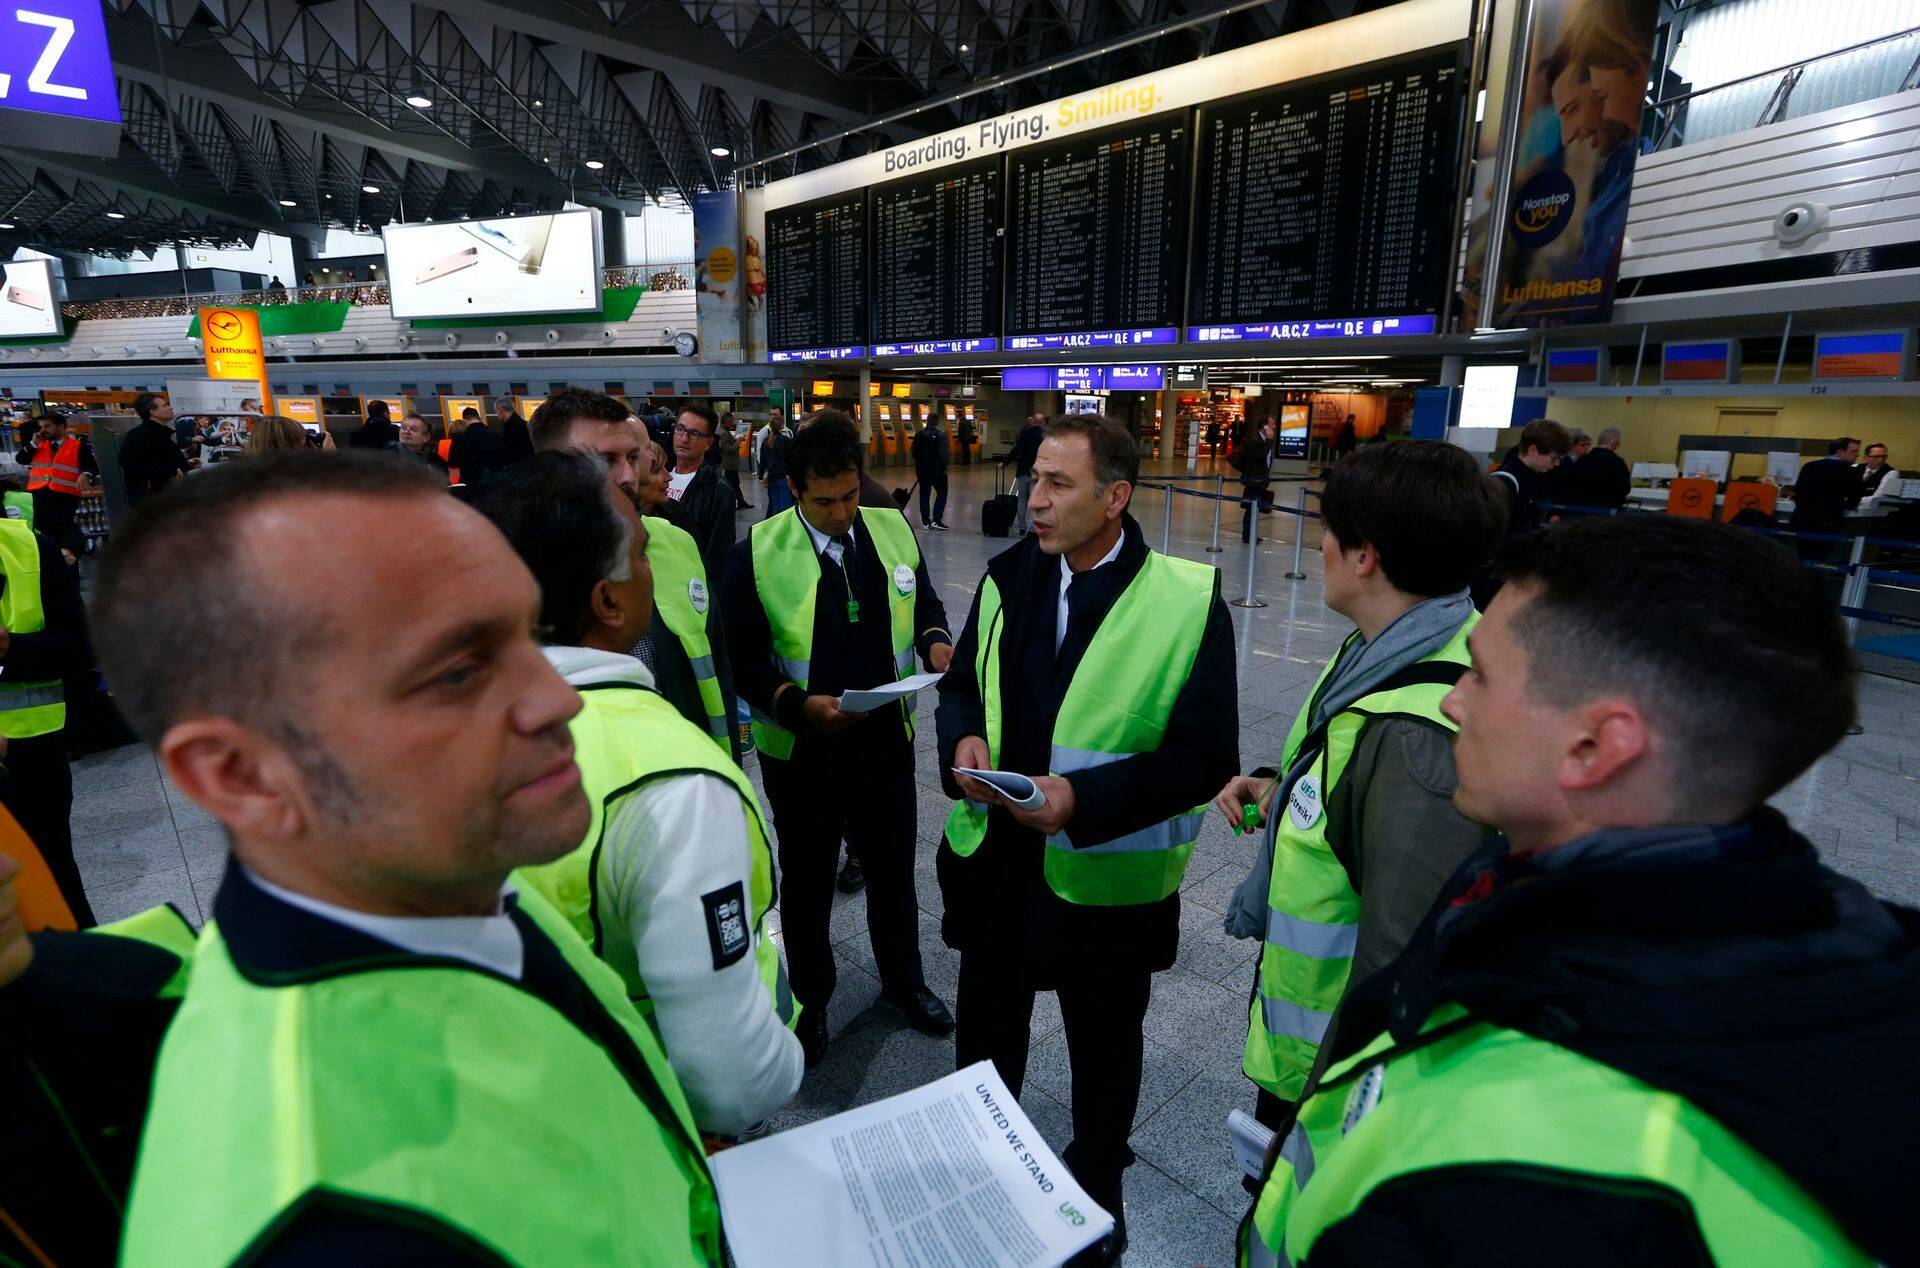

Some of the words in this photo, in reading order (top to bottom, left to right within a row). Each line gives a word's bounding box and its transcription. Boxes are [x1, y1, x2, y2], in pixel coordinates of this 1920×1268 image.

[884, 136, 970, 173] Boarding.
[980, 114, 1050, 148] Flying.
[1058, 82, 1162, 127] Smiling.
[1523, 192, 1570, 211] Nonstop
[1528, 204, 1560, 224] you
[1504, 277, 1602, 302] Lufthansa
[1271, 324, 1309, 338] A,B,C,Z
[1345, 321, 1363, 335] D,E
[1064, 334, 1090, 346] A,B,C,Z
[1115, 332, 1128, 344] D,E
[210, 346, 257, 355] Lufthansa
[914, 344, 934, 354] A,B,C,Z
[952, 342, 961, 351] D,E
[1136, 367, 1148, 376] A,Z
[1301, 780, 1316, 799] UFO
[1290, 792, 1312, 824] Streik!
[976, 1084, 1009, 1129] UNITED
[1006, 1130, 1026, 1152] WE
[1020, 1153, 1054, 1194] STAND
[1059, 1200, 1085, 1227] UFO
